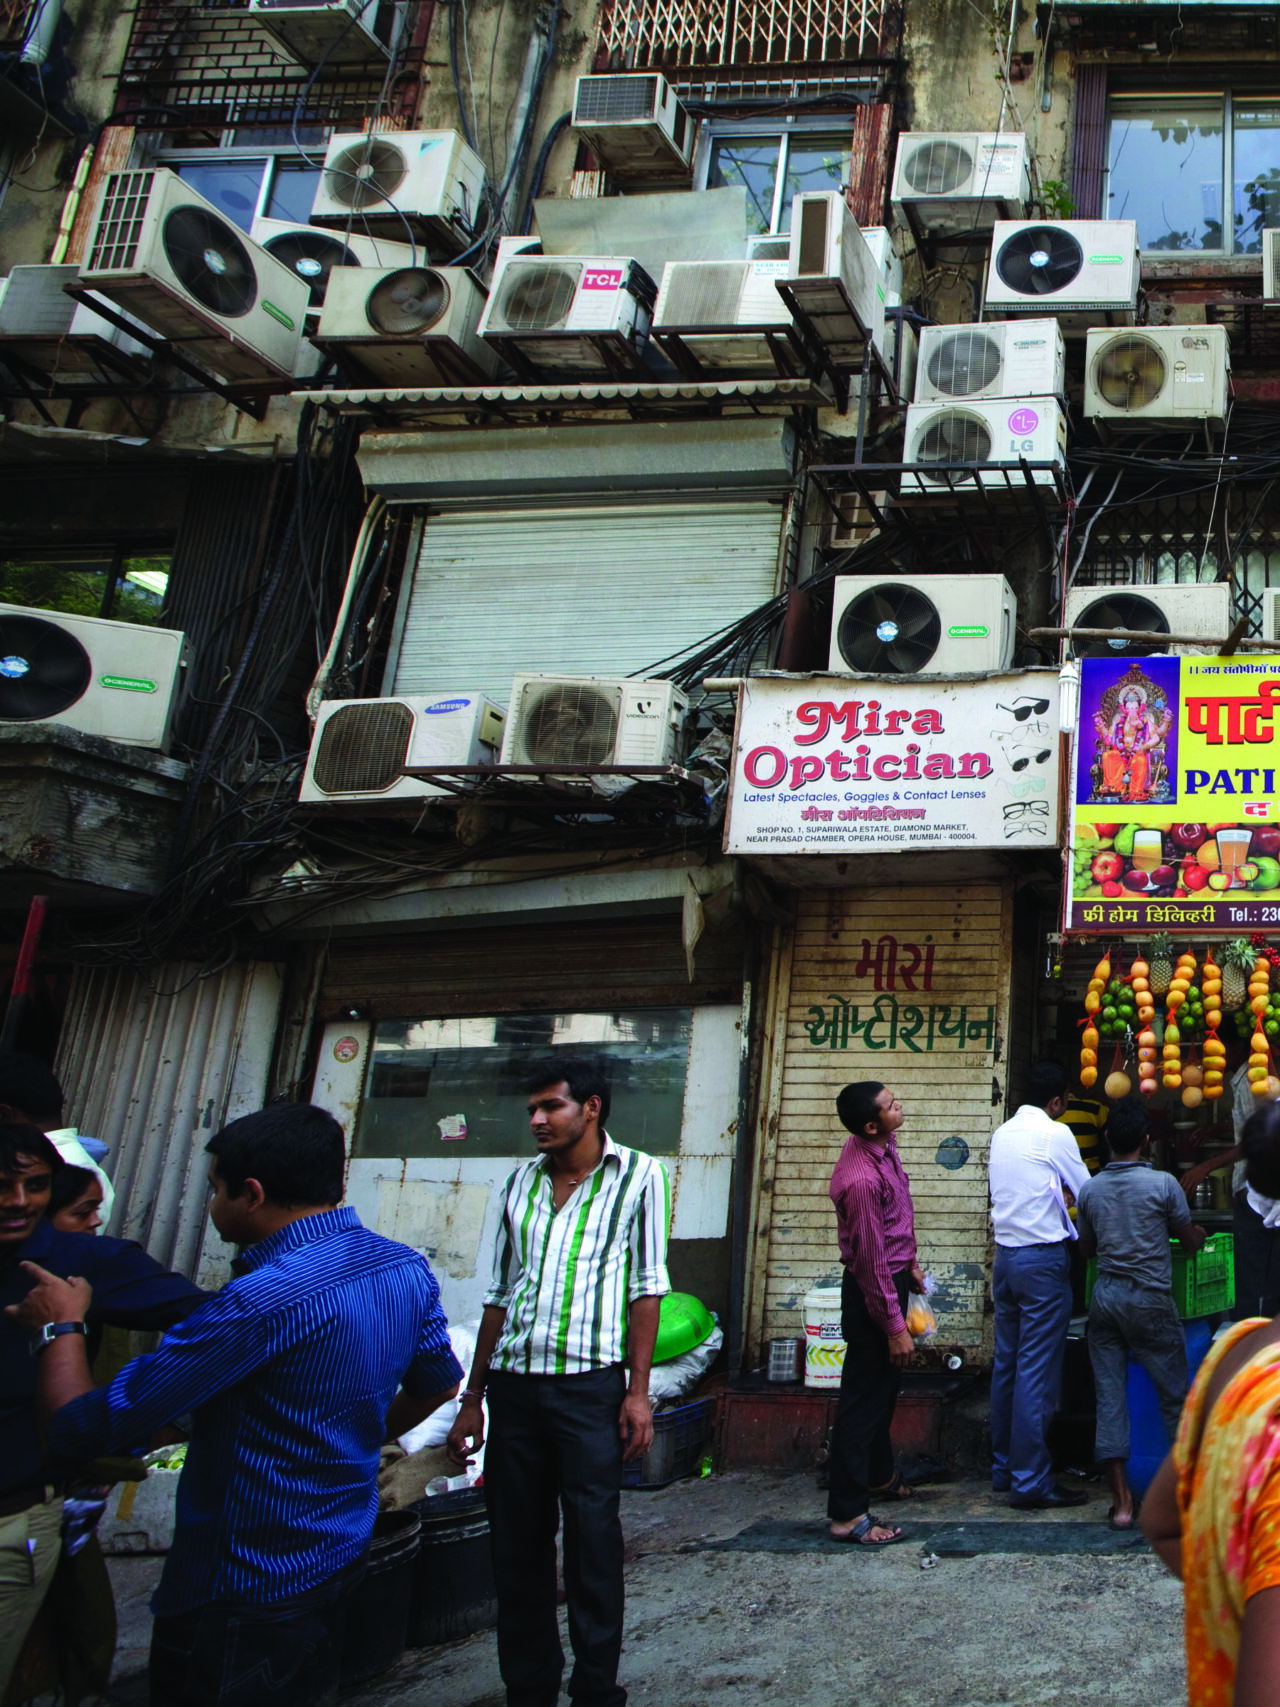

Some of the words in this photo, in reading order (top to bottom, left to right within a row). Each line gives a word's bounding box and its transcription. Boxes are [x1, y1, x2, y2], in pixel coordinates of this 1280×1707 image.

[586, 273, 619, 285] TCL
[1010, 440, 1034, 452] LG
[1201, 665, 1220, 675] जय
[430, 702, 465, 711] SAMSUNG
[793, 699, 945, 746] Mira
[743, 743, 994, 790] Optician
[744, 793, 775, 803] Latest
[778, 792, 840, 804] Spectacles,
[844, 791, 890, 804] Goggles
[893, 791, 901, 801] &
[903, 790, 948, 801] Contact
[951, 789, 987, 800] Lenses
[800, 805, 834, 822] मीरा
[1243, 801, 1271, 817] द
[757, 826, 779, 834] SHOP
[859, 825, 891, 833] ESTATE,
[934, 824, 968, 832] MARKET,
[770, 835, 803, 843] PRASAD
[878, 834, 907, 842] HOUSE,
[1083, 904, 1105, 923] फ्री
[1109, 905, 1138, 923] होम
[1146, 904, 1216, 923] डिलिव्हरी
[1229, 907, 1258, 922] Tel.:
[855, 934, 935, 992] મીરાં
